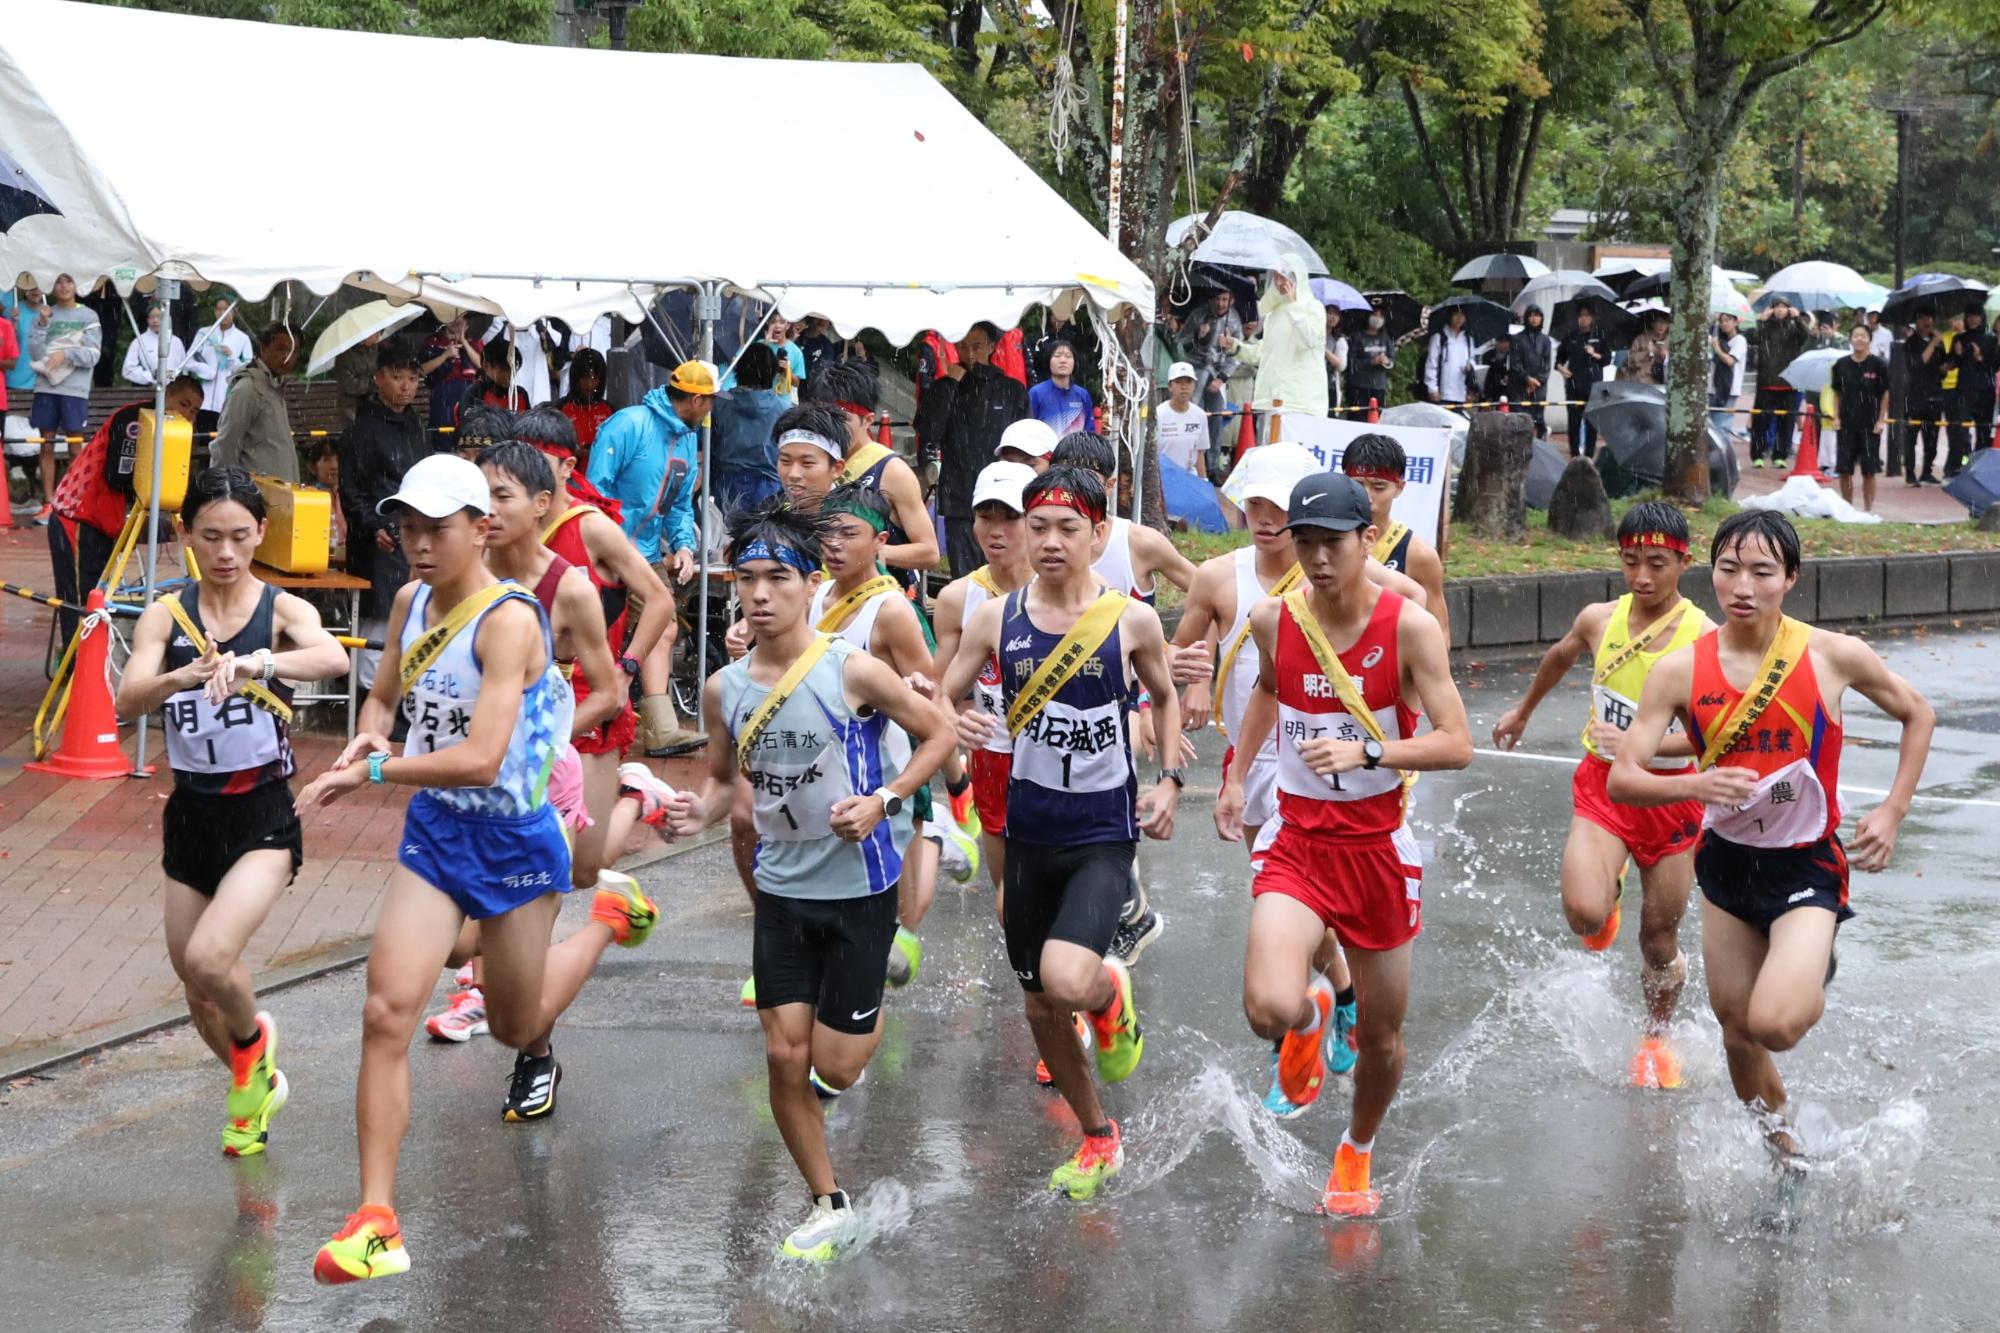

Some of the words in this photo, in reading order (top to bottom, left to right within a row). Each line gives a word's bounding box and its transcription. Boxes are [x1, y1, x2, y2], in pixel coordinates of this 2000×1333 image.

[1014, 657, 1104, 679] 明西
[414, 669, 459, 699] 石北
[163, 693, 254, 733] 明石
[1062, 753, 1072, 788] 1
[779, 804, 798, 830] 1
